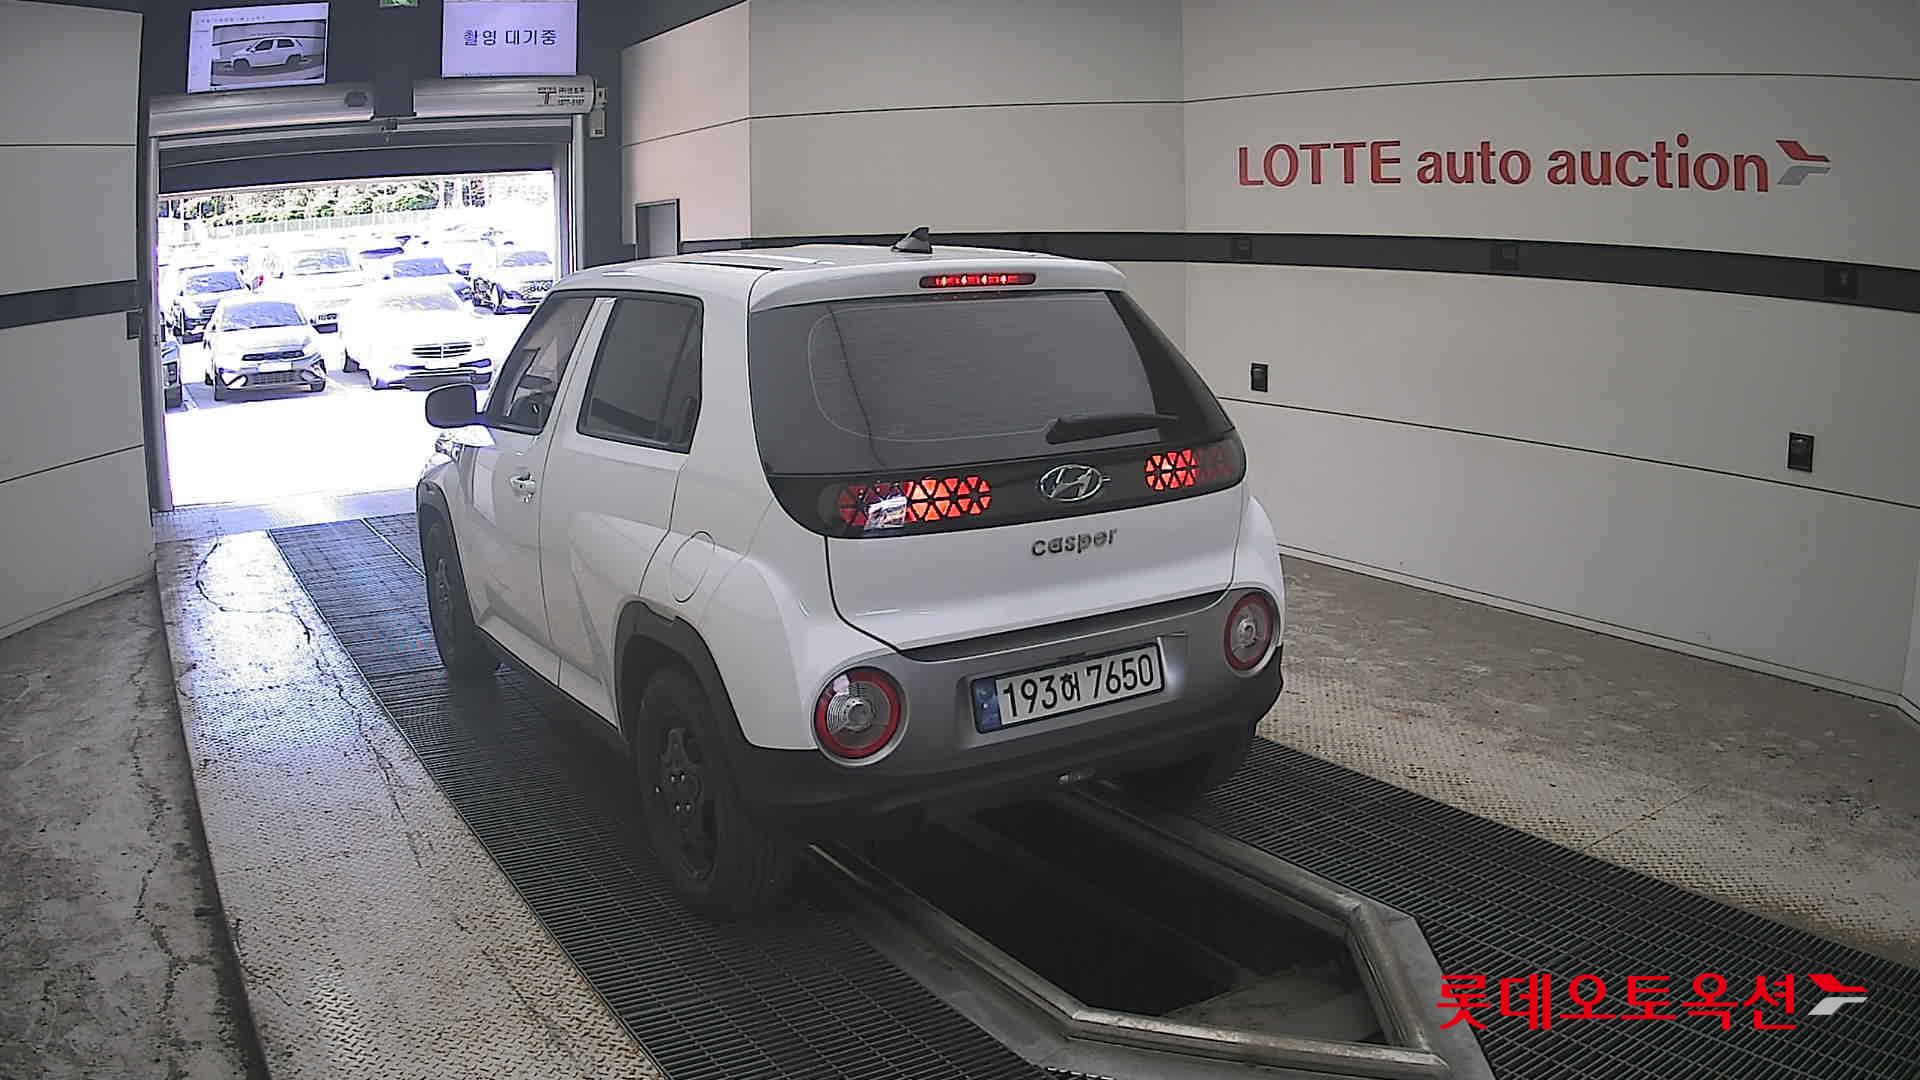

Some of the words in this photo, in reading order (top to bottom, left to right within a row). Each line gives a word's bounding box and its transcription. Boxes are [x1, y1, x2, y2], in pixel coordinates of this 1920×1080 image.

[464, 29, 497, 46] 촬영
[505, 29, 557, 46] 대기중
[1238, 140, 1401, 187] LOTTE
[1416, 141, 1532, 186] auto
[1547, 133, 1769, 193] auction
[1032, 529, 1118, 557] casper
[1087, 654, 1154, 699] 7650
